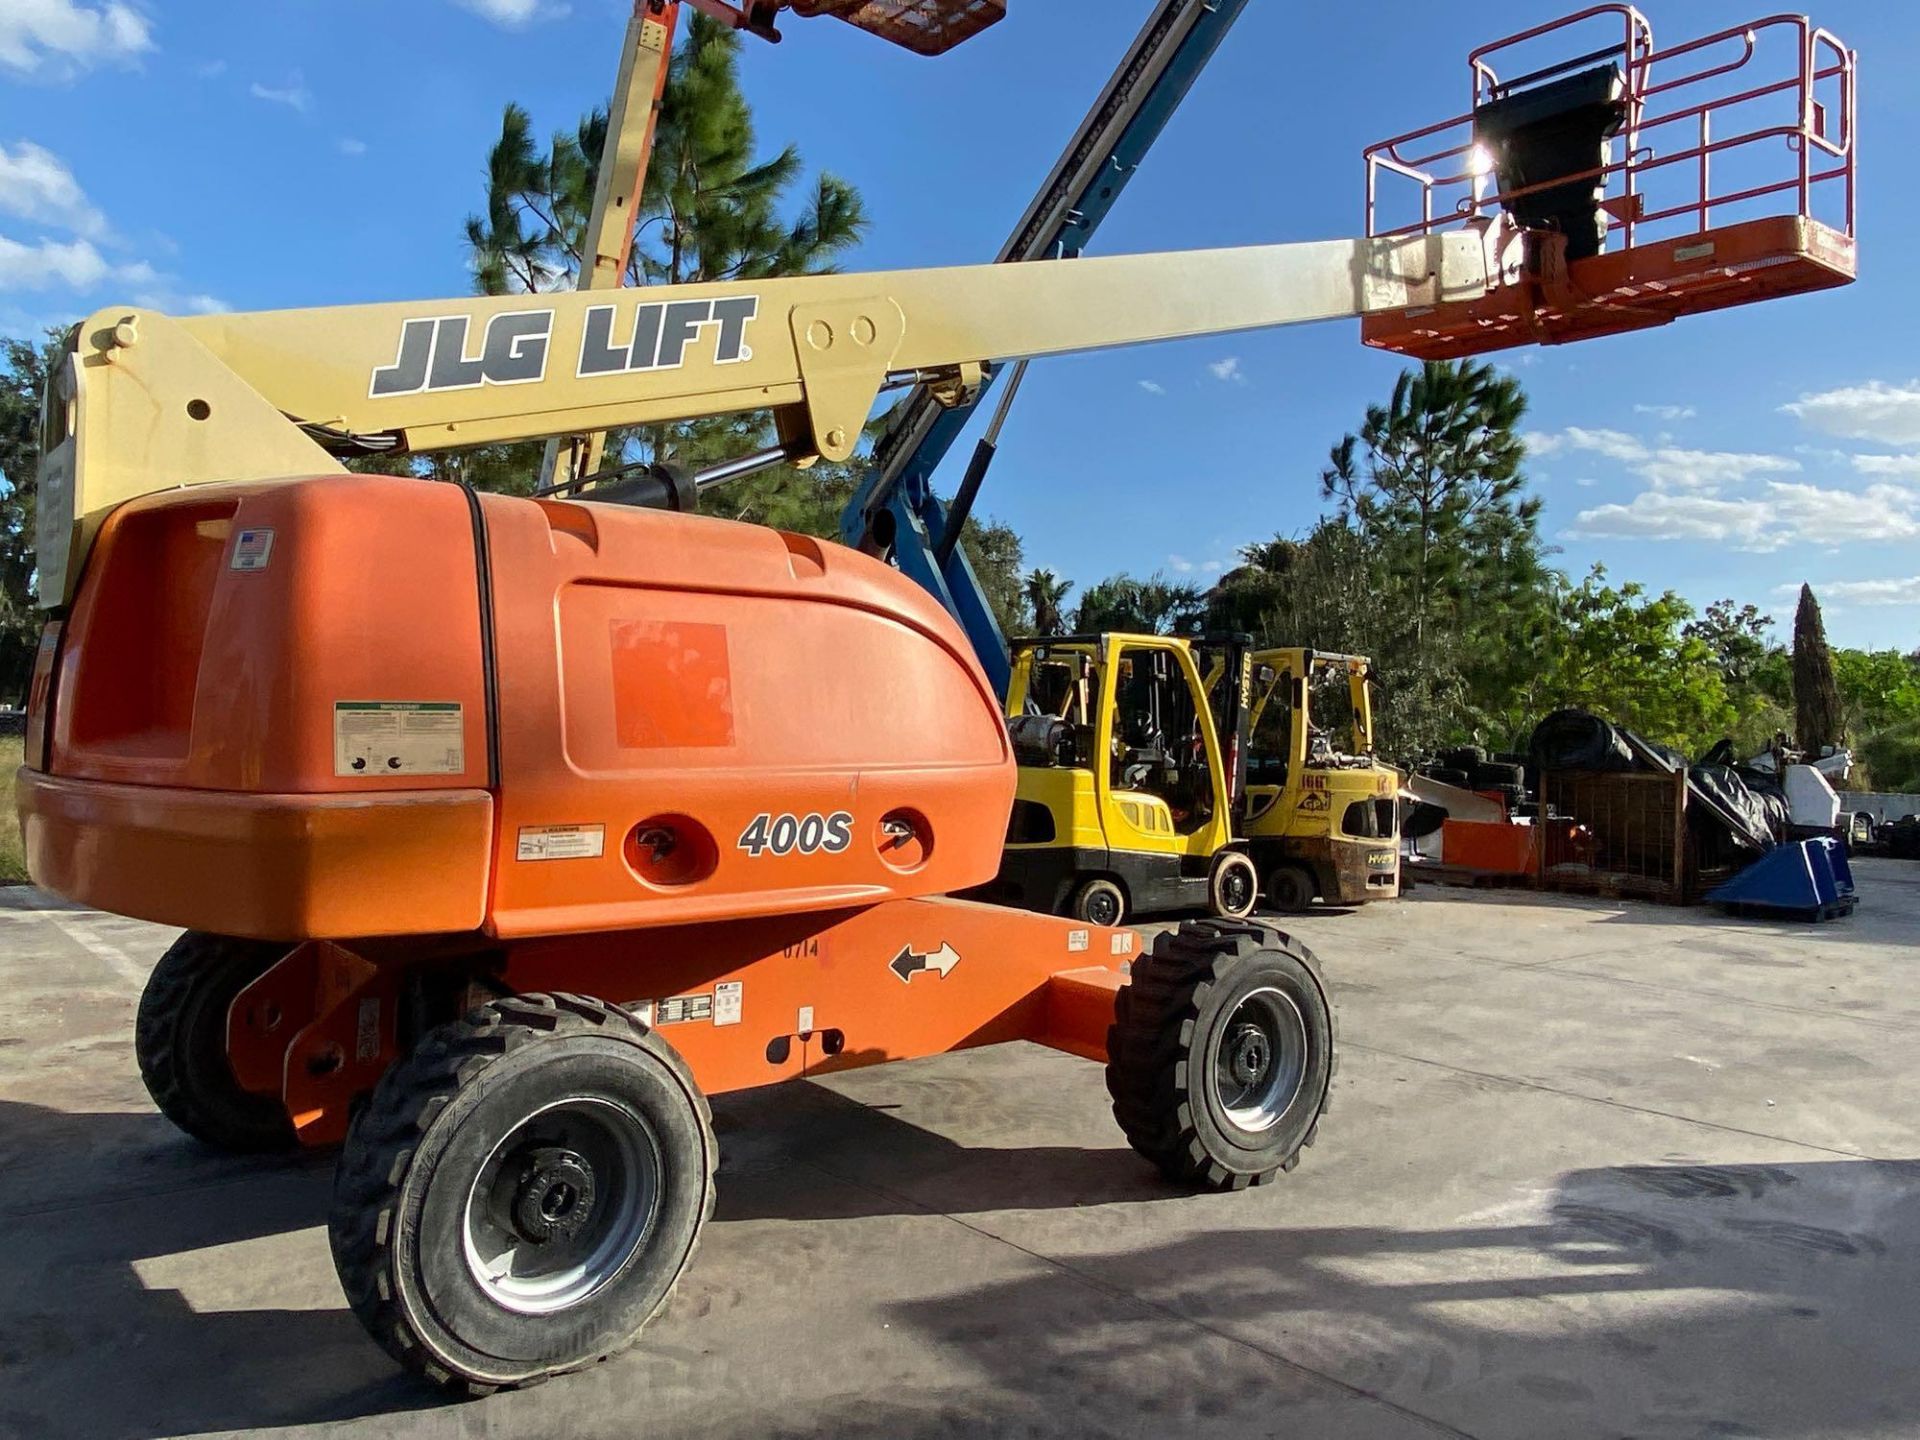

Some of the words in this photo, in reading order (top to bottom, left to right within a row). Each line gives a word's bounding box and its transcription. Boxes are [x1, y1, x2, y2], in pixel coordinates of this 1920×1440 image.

[368, 308, 556, 399] JLG
[575, 294, 760, 379] LIFT
[1240, 651, 1251, 709] HYSTER
[737, 810, 856, 857] 400S
